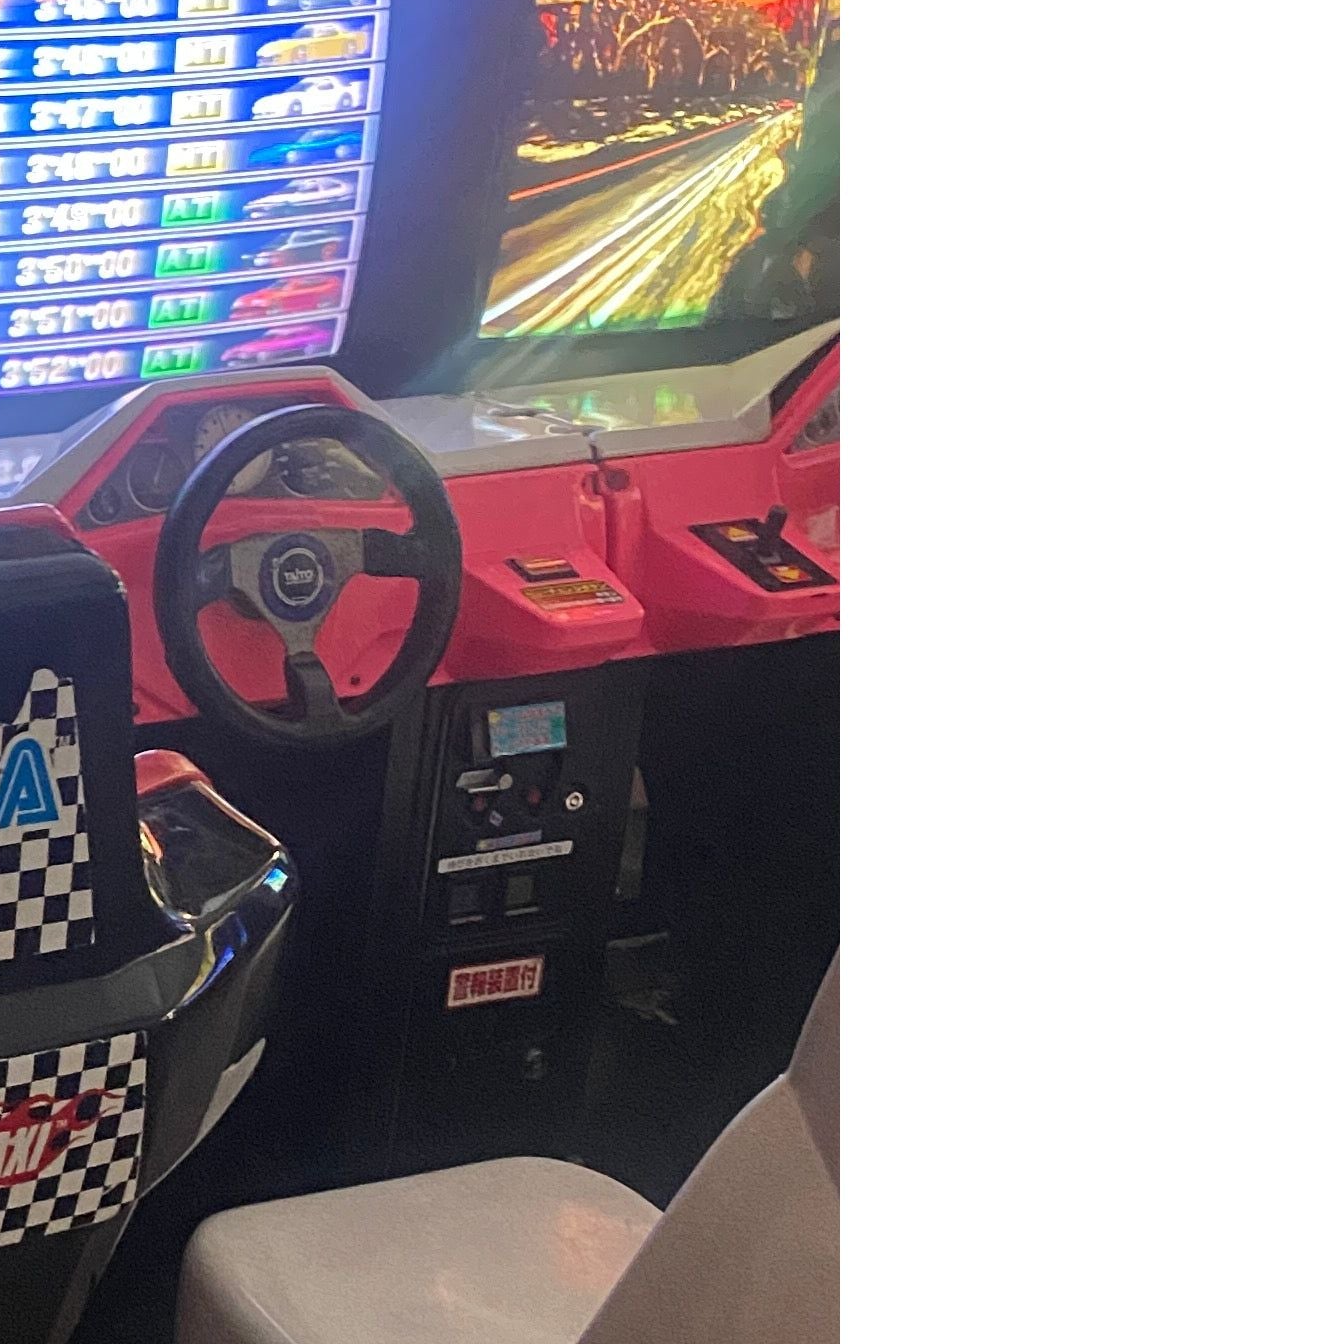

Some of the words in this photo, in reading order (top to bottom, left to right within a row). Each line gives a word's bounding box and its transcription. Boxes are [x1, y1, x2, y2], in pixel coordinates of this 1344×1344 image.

[166, 197, 215, 222] AT
[162, 246, 209, 273] AT
[152, 295, 202, 324] AT
[144, 345, 195, 374] AT
